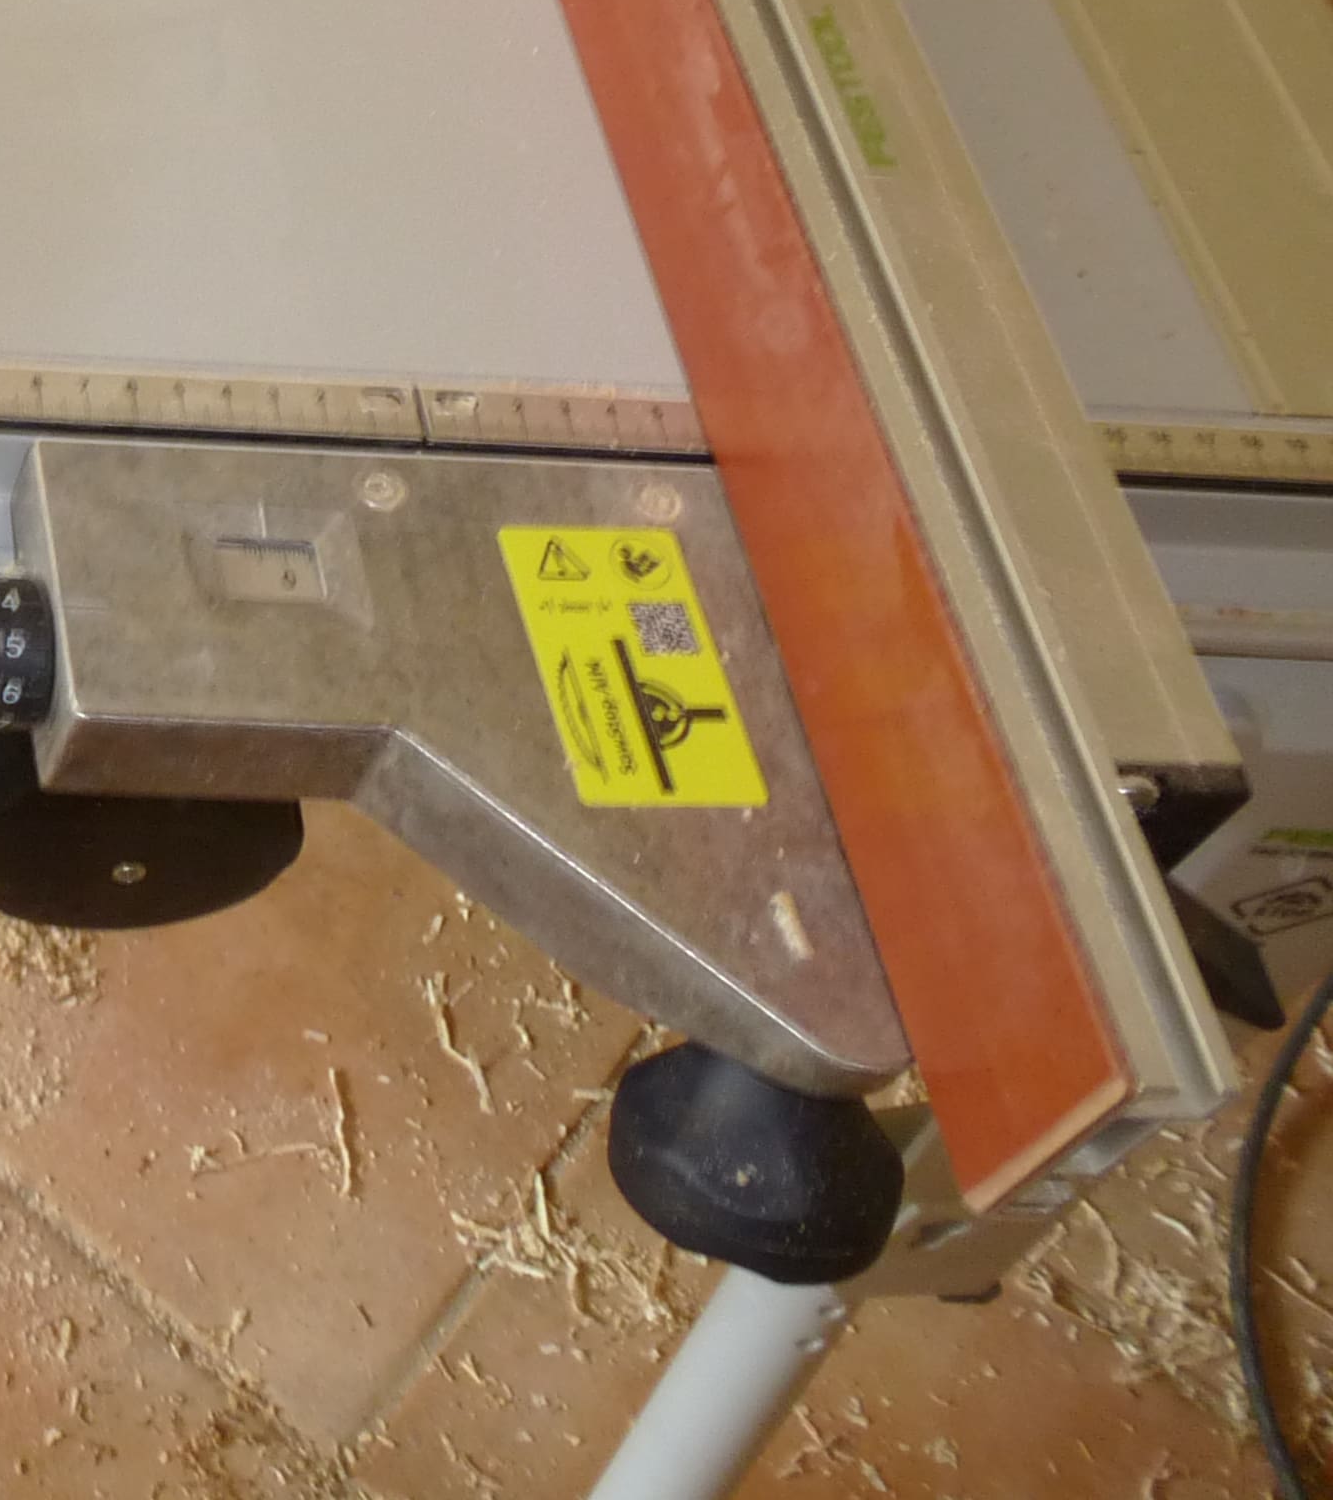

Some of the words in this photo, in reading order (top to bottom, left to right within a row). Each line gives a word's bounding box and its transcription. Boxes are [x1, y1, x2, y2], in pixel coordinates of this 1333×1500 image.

[1, 588, 21, 612] 4
[5, 629, 26, 659] 5
[2, 678, 22, 705] 6
